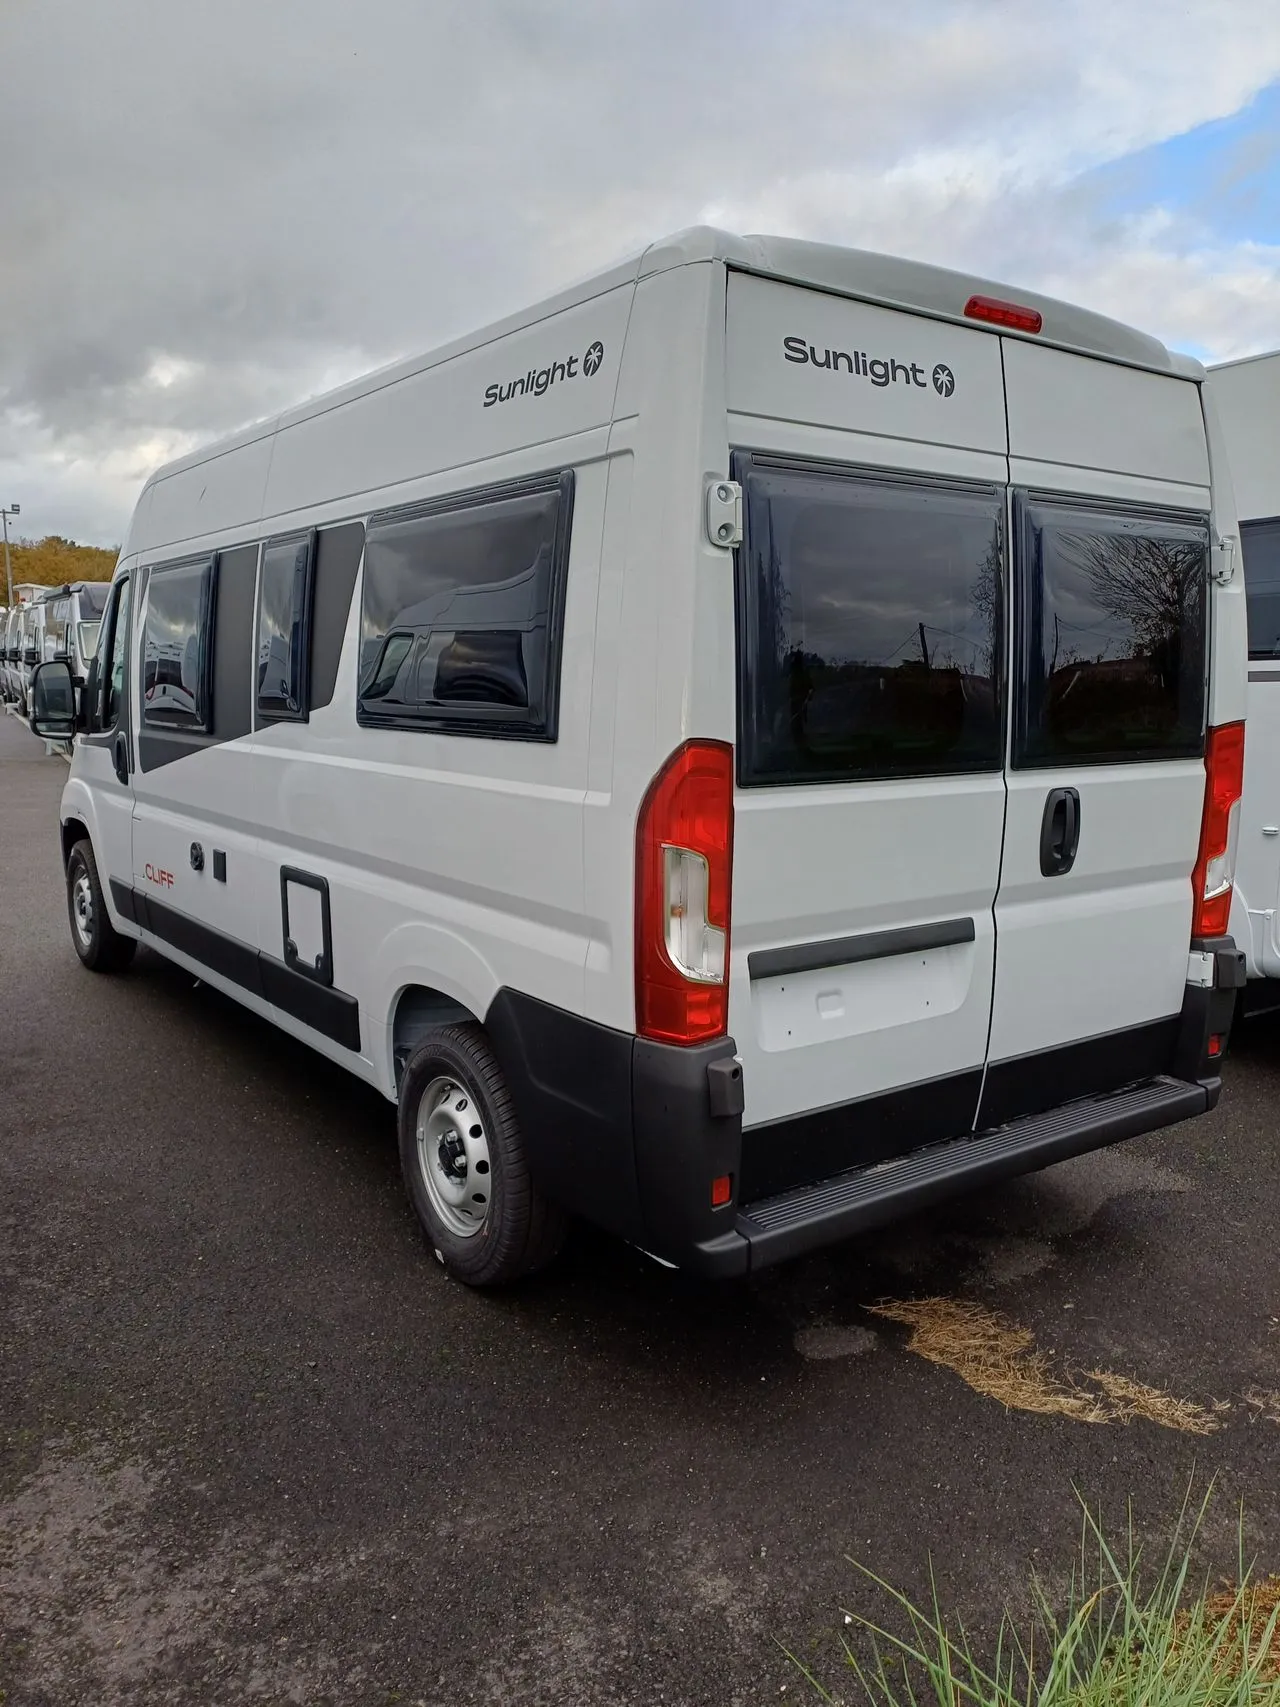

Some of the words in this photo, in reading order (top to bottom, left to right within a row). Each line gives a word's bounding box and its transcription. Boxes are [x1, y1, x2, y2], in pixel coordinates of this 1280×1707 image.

[483, 355, 578, 407] Sunlight
[783, 336, 926, 387] Sunlight
[145, 863, 174, 889] CLIFF
